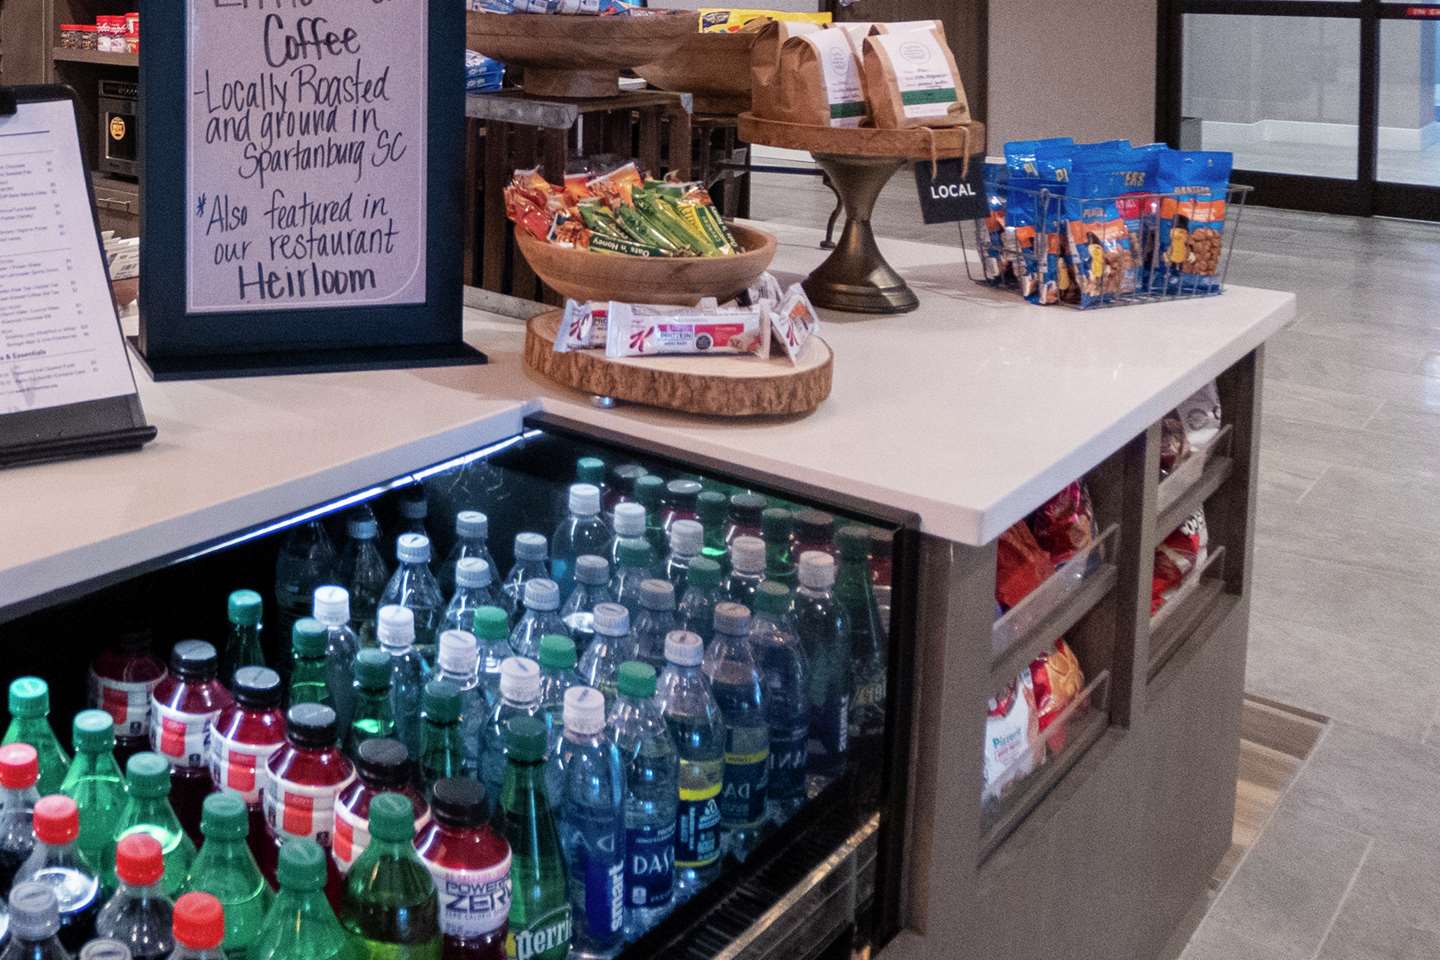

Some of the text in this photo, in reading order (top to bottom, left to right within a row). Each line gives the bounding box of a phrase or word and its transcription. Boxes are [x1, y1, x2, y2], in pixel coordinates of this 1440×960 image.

[263, 13, 361, 68] Coffee
[291, 59, 390, 106] Roasted
[206, 106, 379, 151] and ground in
[239, 130, 408, 189] Spartanburg SC
[264, 189, 353, 229] featured
[363, 194, 388, 219] in
[931, 183, 976, 199] LOCAL
[214, 218, 400, 265] our restaurant
[592, 236, 619, 251] Honey
[630, 247, 650, 257] Oats
[238, 262, 376, 300] Heirloom
[633, 847, 675, 875] DAS
[446, 881, 506, 895] POWER
[609, 860, 624, 931] smart
